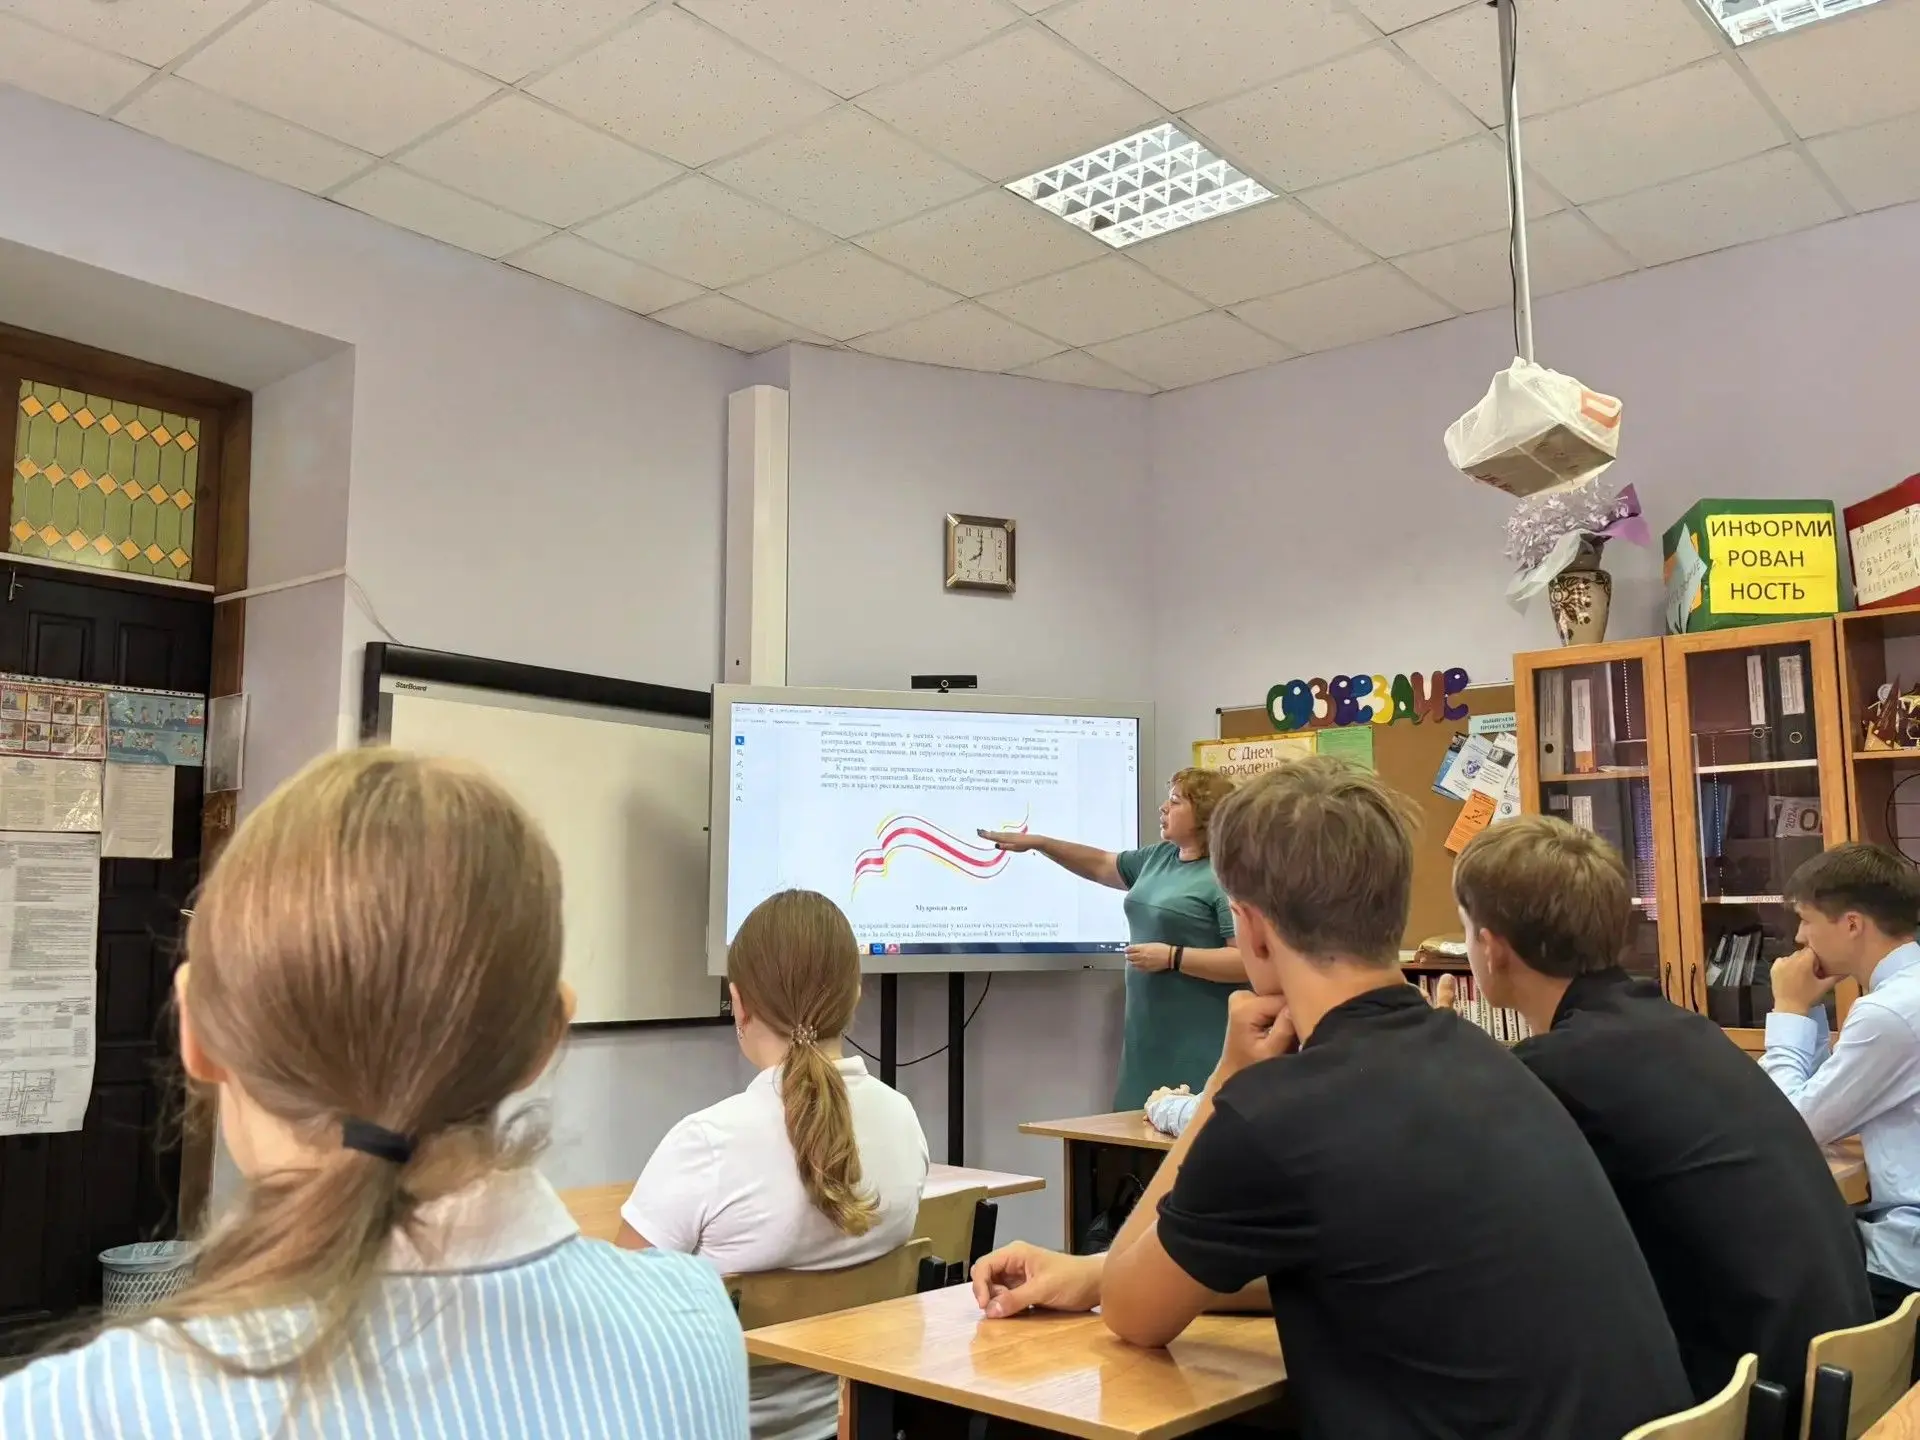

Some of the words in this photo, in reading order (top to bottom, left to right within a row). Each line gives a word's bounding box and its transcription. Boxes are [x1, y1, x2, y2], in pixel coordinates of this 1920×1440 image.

[1711, 520, 1833, 537] ИНФОРМИ
[1728, 550, 1804, 567] РОВАН
[1730, 583, 1805, 600] НОСТЬ
[395, 681, 428, 692] StarBoard
[1266, 667, 1470, 731] СОЗВЕЗДИЕ
[1227, 747, 1236, 760] С
[1241, 746, 1274, 760] Днем
[1219, 761, 1281, 777] рождени
